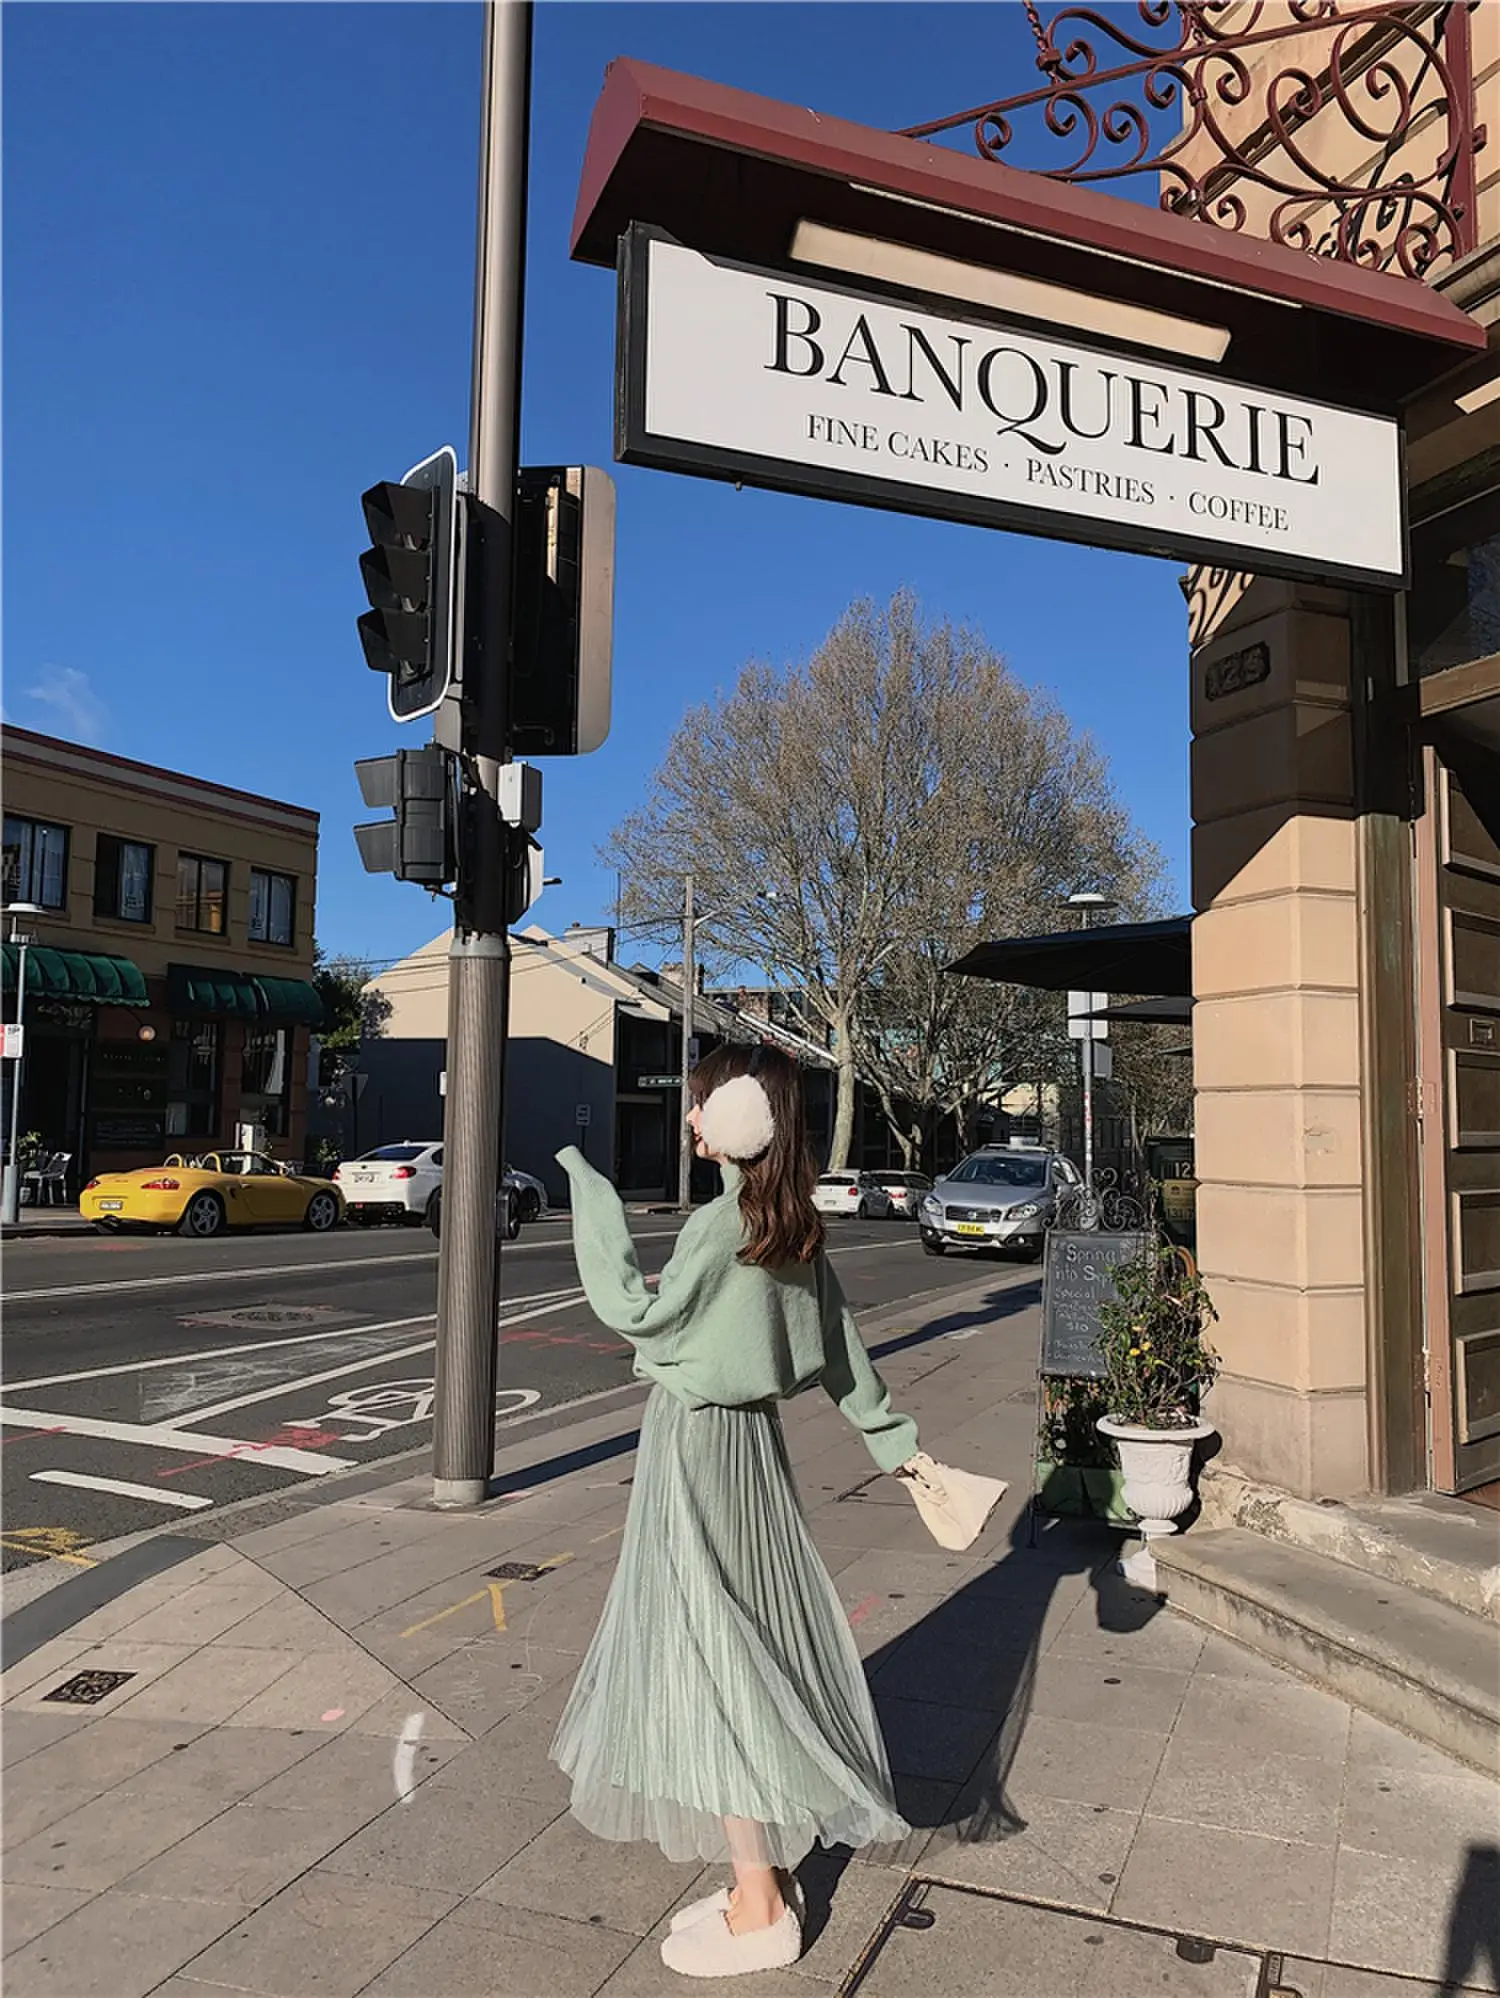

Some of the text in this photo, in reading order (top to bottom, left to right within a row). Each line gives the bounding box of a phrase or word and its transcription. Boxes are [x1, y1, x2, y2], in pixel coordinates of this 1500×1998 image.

[763, 291, 1319, 486] BANQUERIE
[807, 414, 1290, 531] FINE CAKES PASTRIES COFFEE
[1056, 1264, 1078, 1282] into
[1066, 1243, 1117, 1266] Spring
